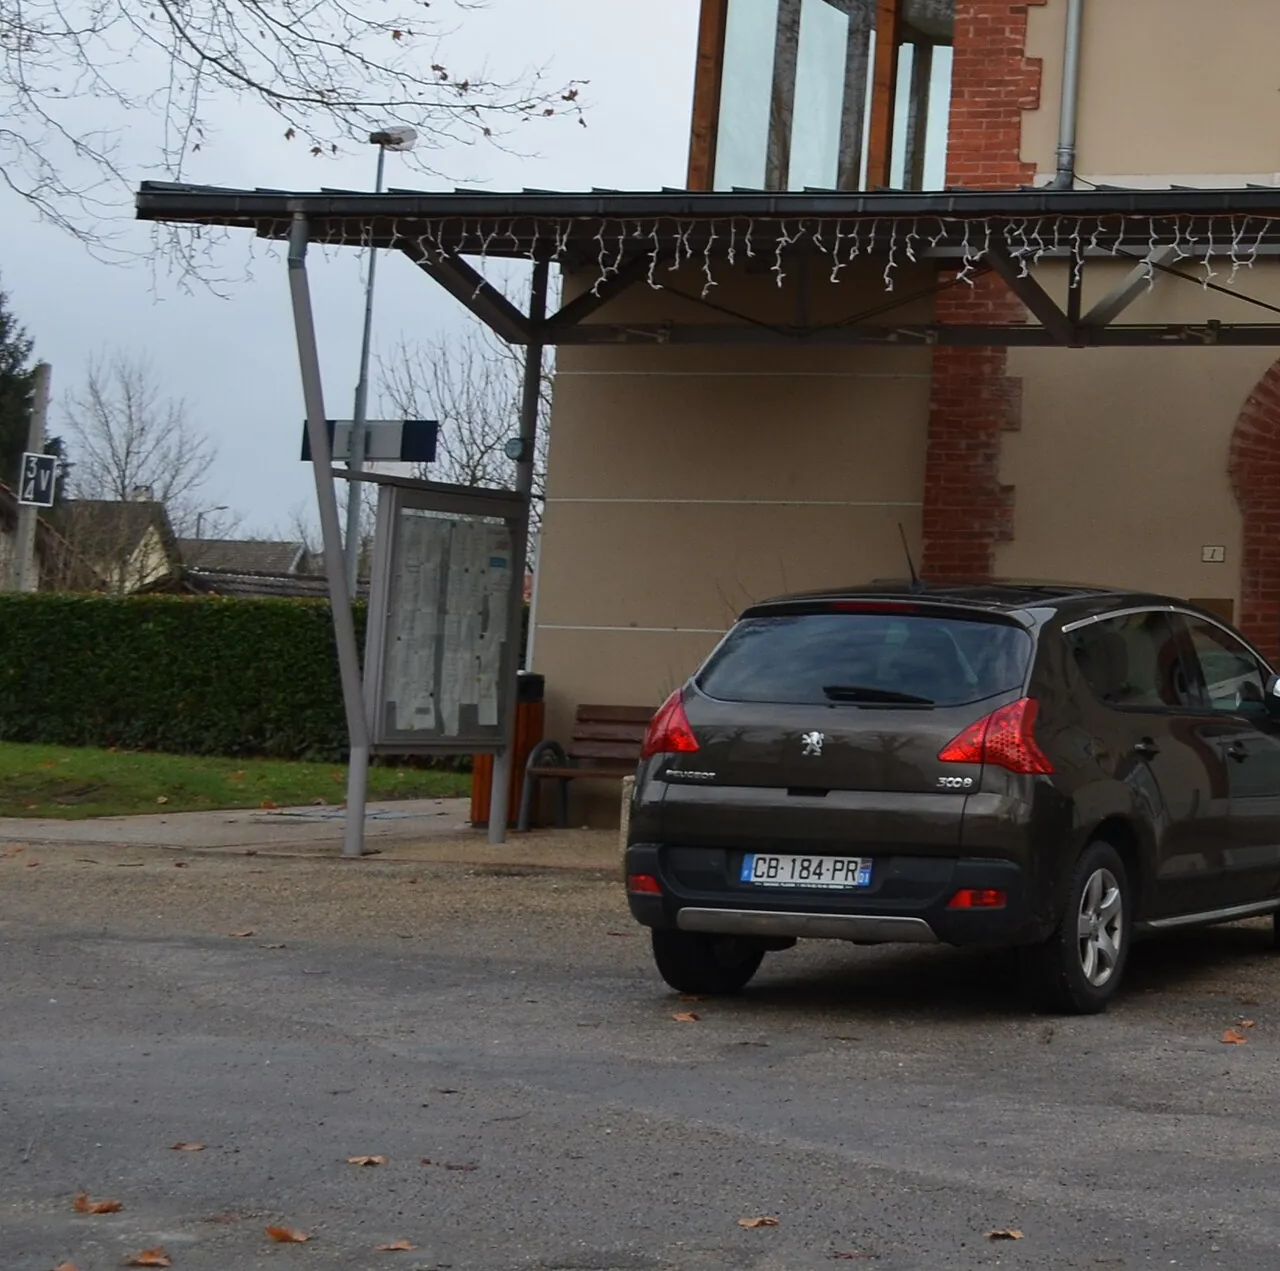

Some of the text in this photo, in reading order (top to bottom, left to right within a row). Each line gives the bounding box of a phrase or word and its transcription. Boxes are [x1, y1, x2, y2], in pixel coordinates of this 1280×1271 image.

[26, 456, 39, 479] 3
[24, 479, 36, 501] 4
[40, 469, 51, 492] V
[935, 776, 974, 789] 3008
[753, 857, 858, 882] CB-184-PR
